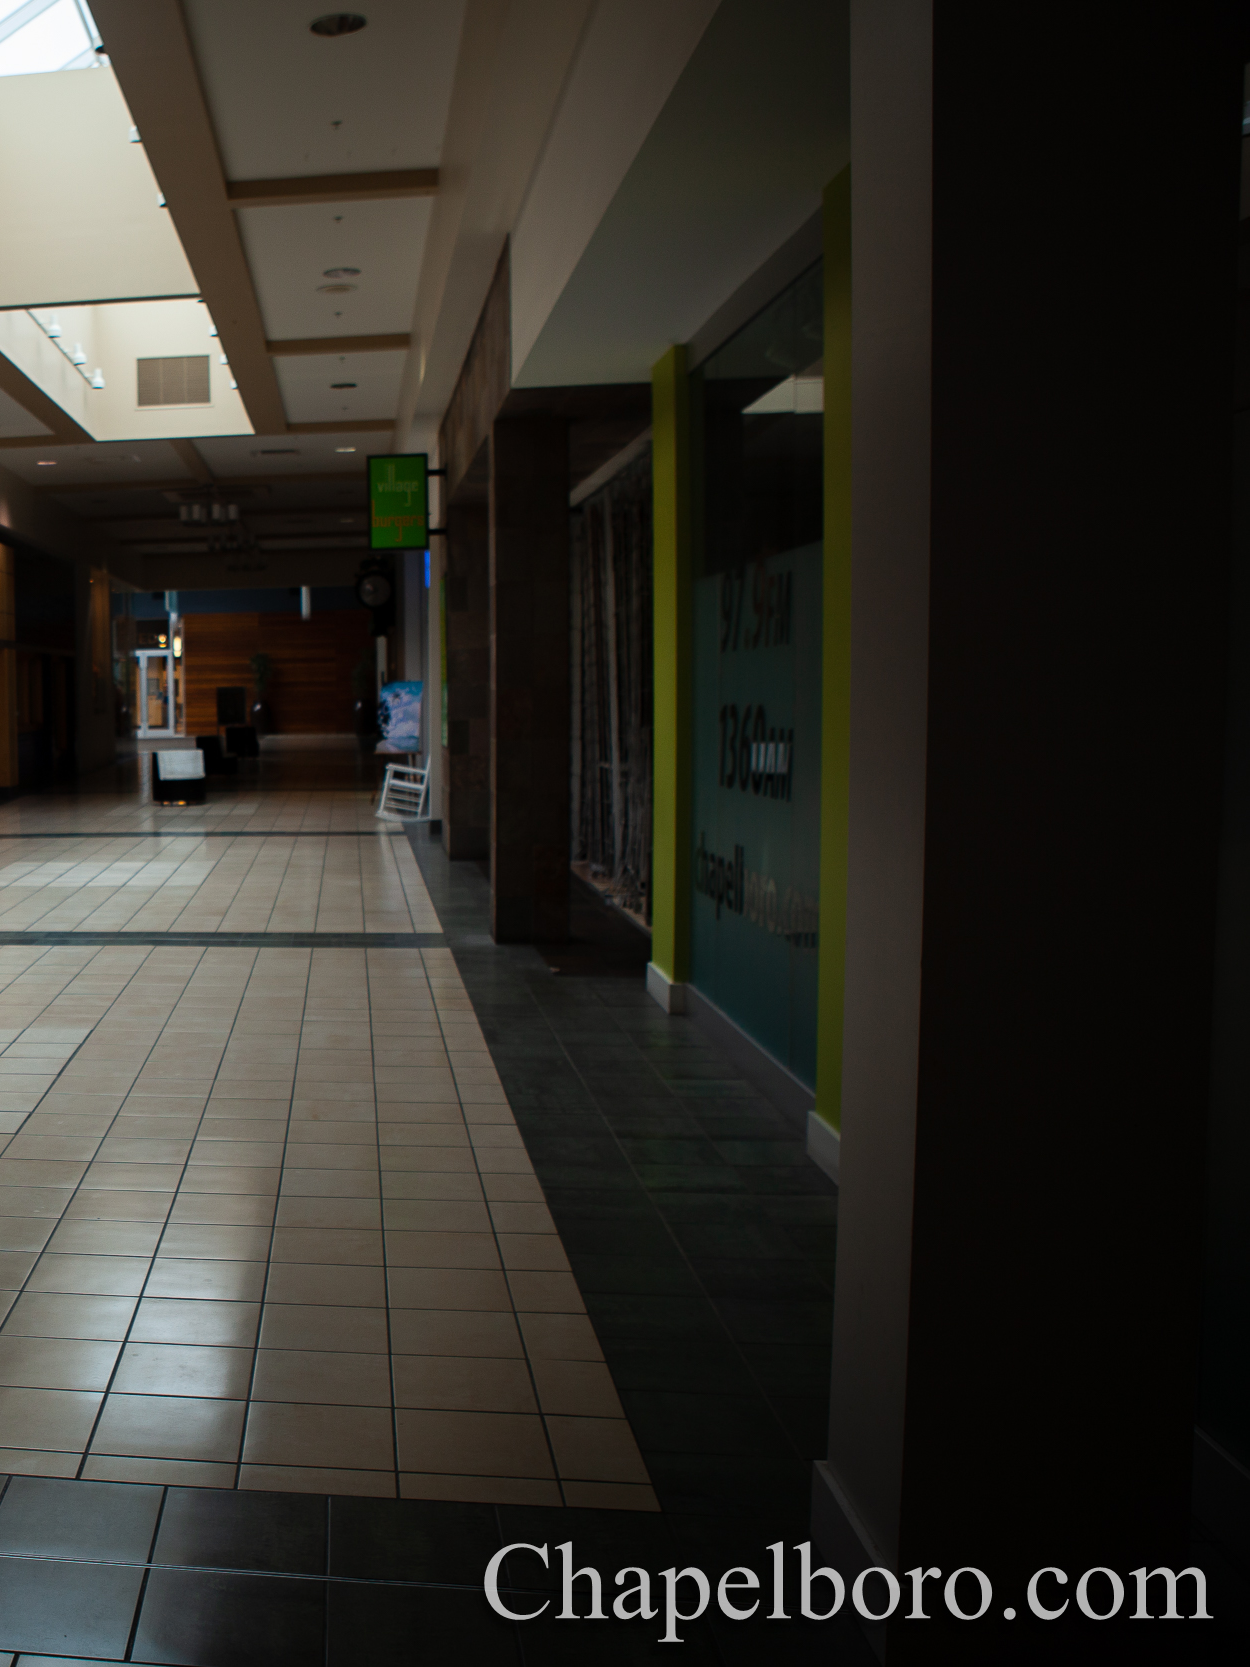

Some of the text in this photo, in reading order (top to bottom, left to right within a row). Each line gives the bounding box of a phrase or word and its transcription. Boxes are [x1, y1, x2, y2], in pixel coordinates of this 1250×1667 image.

[376, 464, 419, 507] village
[371, 500, 425, 542] burgers
[718, 702, 795, 802] 1360AM
